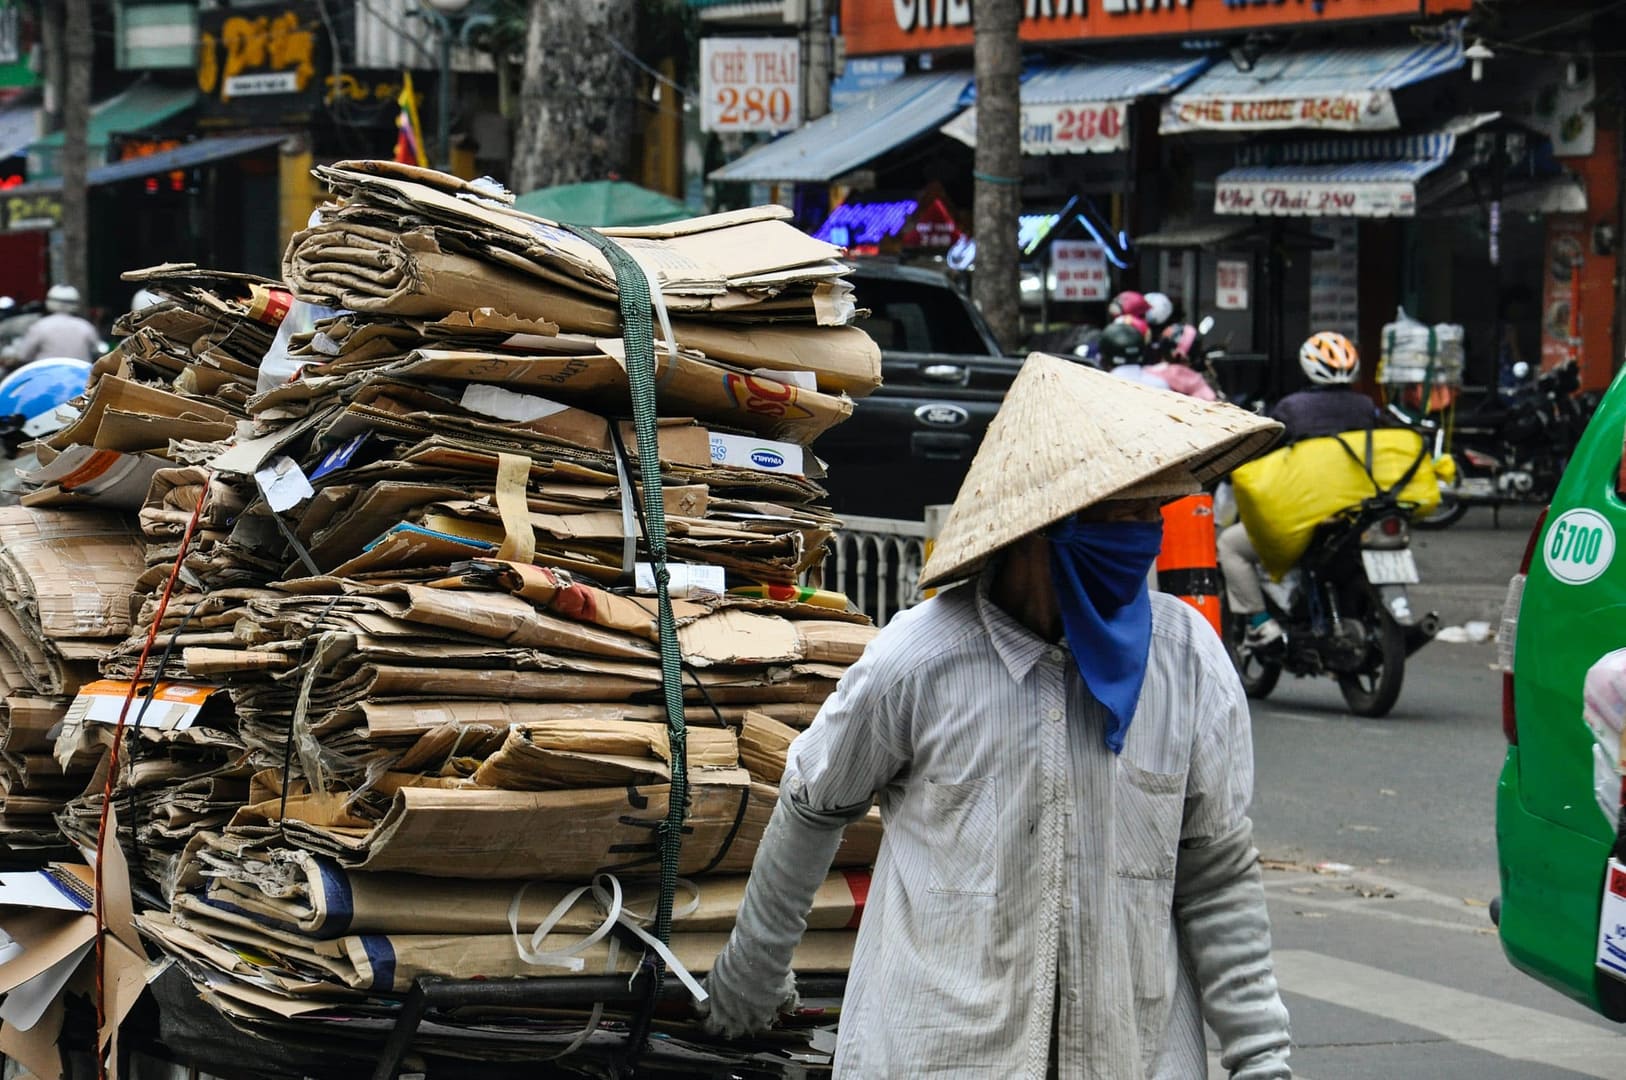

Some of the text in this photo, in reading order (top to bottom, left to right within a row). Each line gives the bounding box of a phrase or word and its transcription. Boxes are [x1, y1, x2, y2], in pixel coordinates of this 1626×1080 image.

[710, 44, 796, 84] CHÈ THÁI
[717, 86, 791, 125] 280
[1056, 105, 1121, 141] 280
[752, 454, 782, 465] VINAMILK
[1550, 520, 1603, 565] 6700
